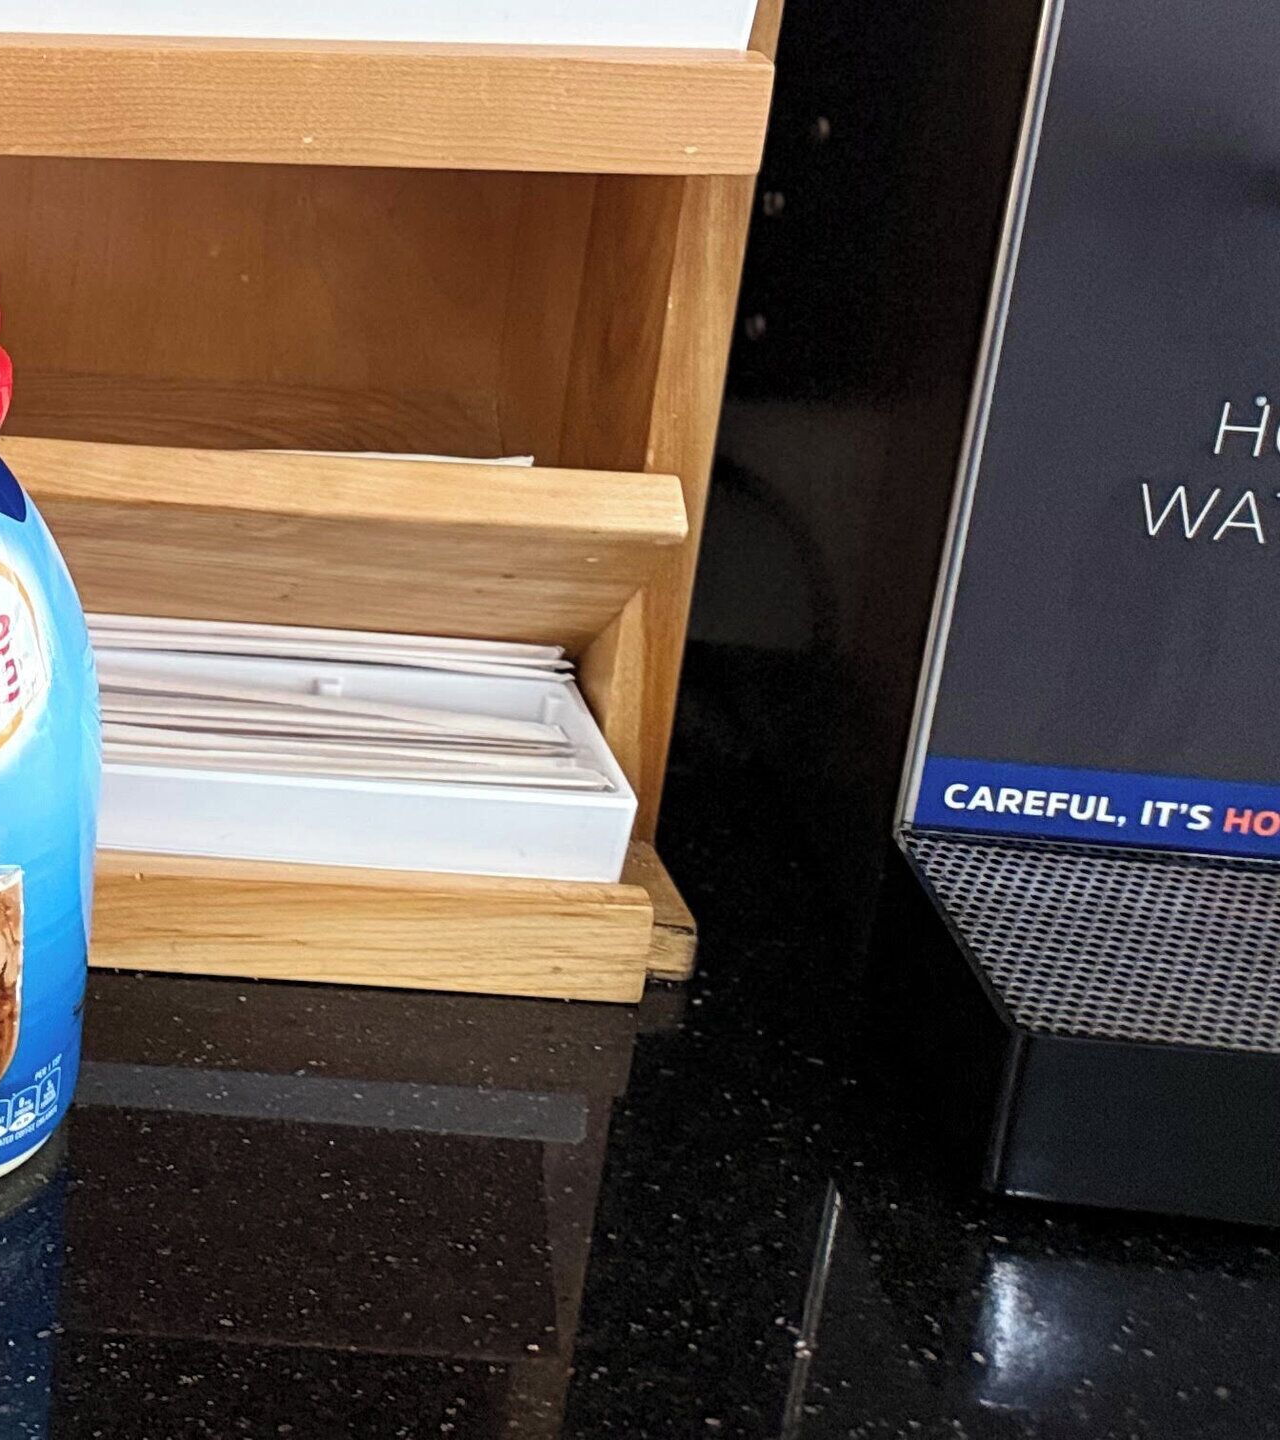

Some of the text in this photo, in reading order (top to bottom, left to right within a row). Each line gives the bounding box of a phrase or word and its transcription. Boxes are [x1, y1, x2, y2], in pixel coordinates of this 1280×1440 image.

[1214, 401, 1280, 458] H
[1141, 482, 1280, 545] WA
[943, 783, 1126, 827] CAREFUL,
[1139, 800, 1213, 831] IT'S
